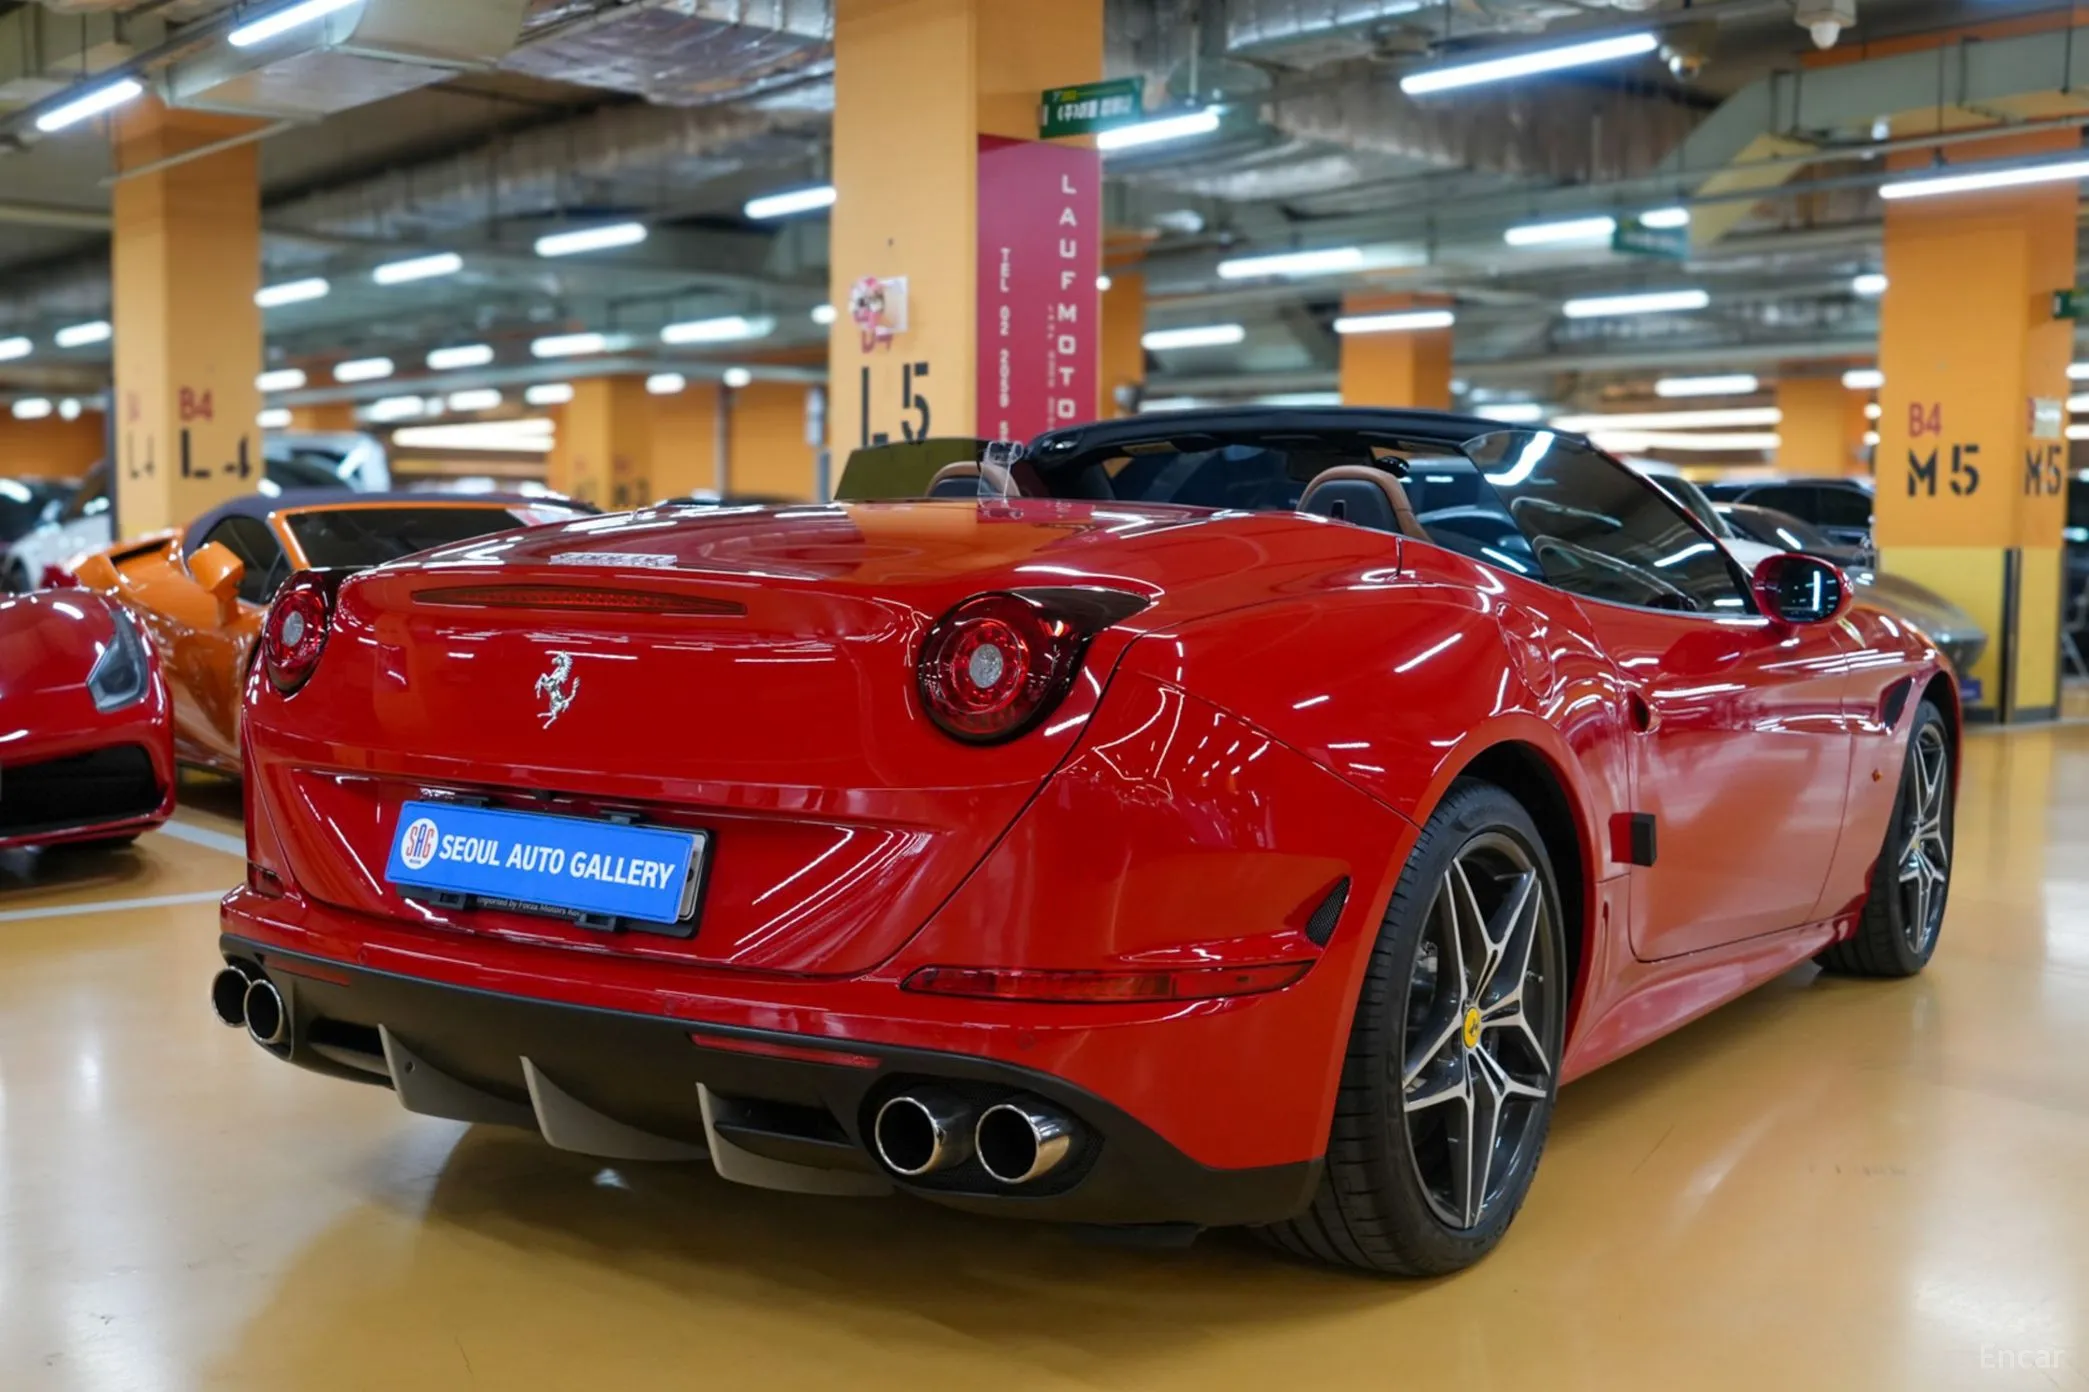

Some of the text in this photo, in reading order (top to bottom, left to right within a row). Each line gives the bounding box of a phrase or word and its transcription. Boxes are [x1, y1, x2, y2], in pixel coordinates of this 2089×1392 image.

[1000, 248, 1011, 292] TEL
[179, 385, 213, 422] B4
[1908, 401, 1942, 438] B4
[405, 823, 435, 859] SAG
[438, 834, 676, 890] SEOUL AUTO GALLERY
[509, 899, 517, 910] by
